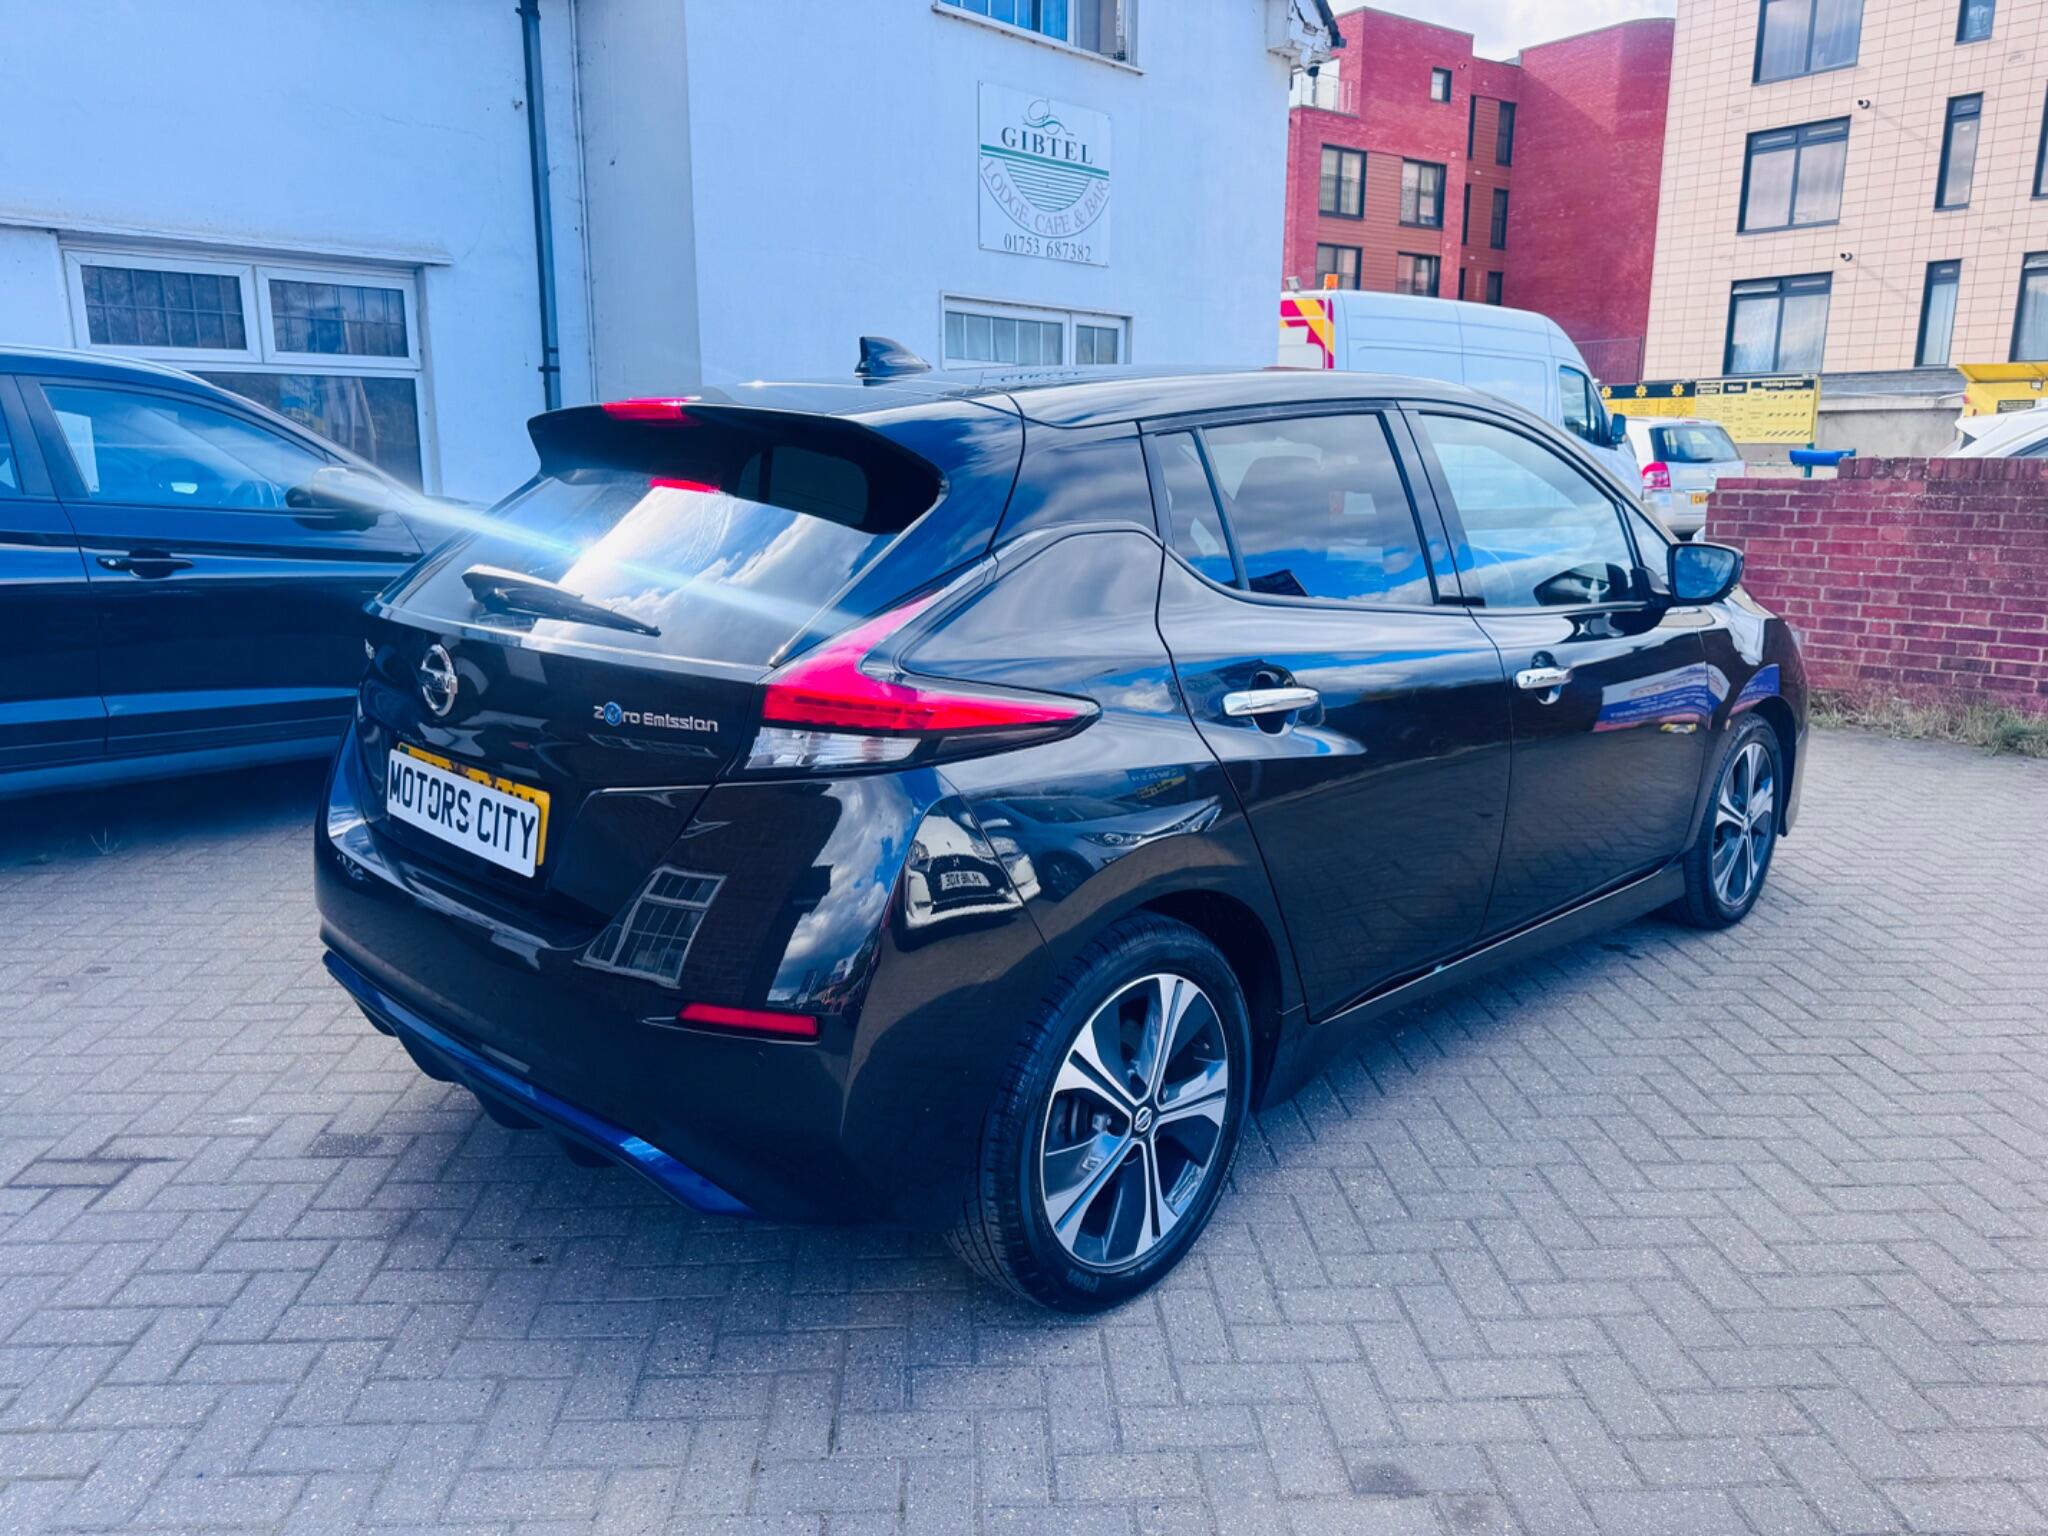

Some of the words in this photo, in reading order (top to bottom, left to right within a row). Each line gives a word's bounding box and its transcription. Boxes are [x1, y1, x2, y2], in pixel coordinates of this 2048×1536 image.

[1001, 126, 1093, 165] GIBTEL
[1034, 212, 1071, 235] CAFE
[1073, 211, 1087, 228] &
[1086, 179, 1110, 217] BAR
[1004, 232, 1041, 255] 01753
[1046, 239, 1092, 262] 687382
[643, 711, 719, 733] Emission
[389, 759, 472, 834] MOTORS
[477, 797, 537, 861] CITY
